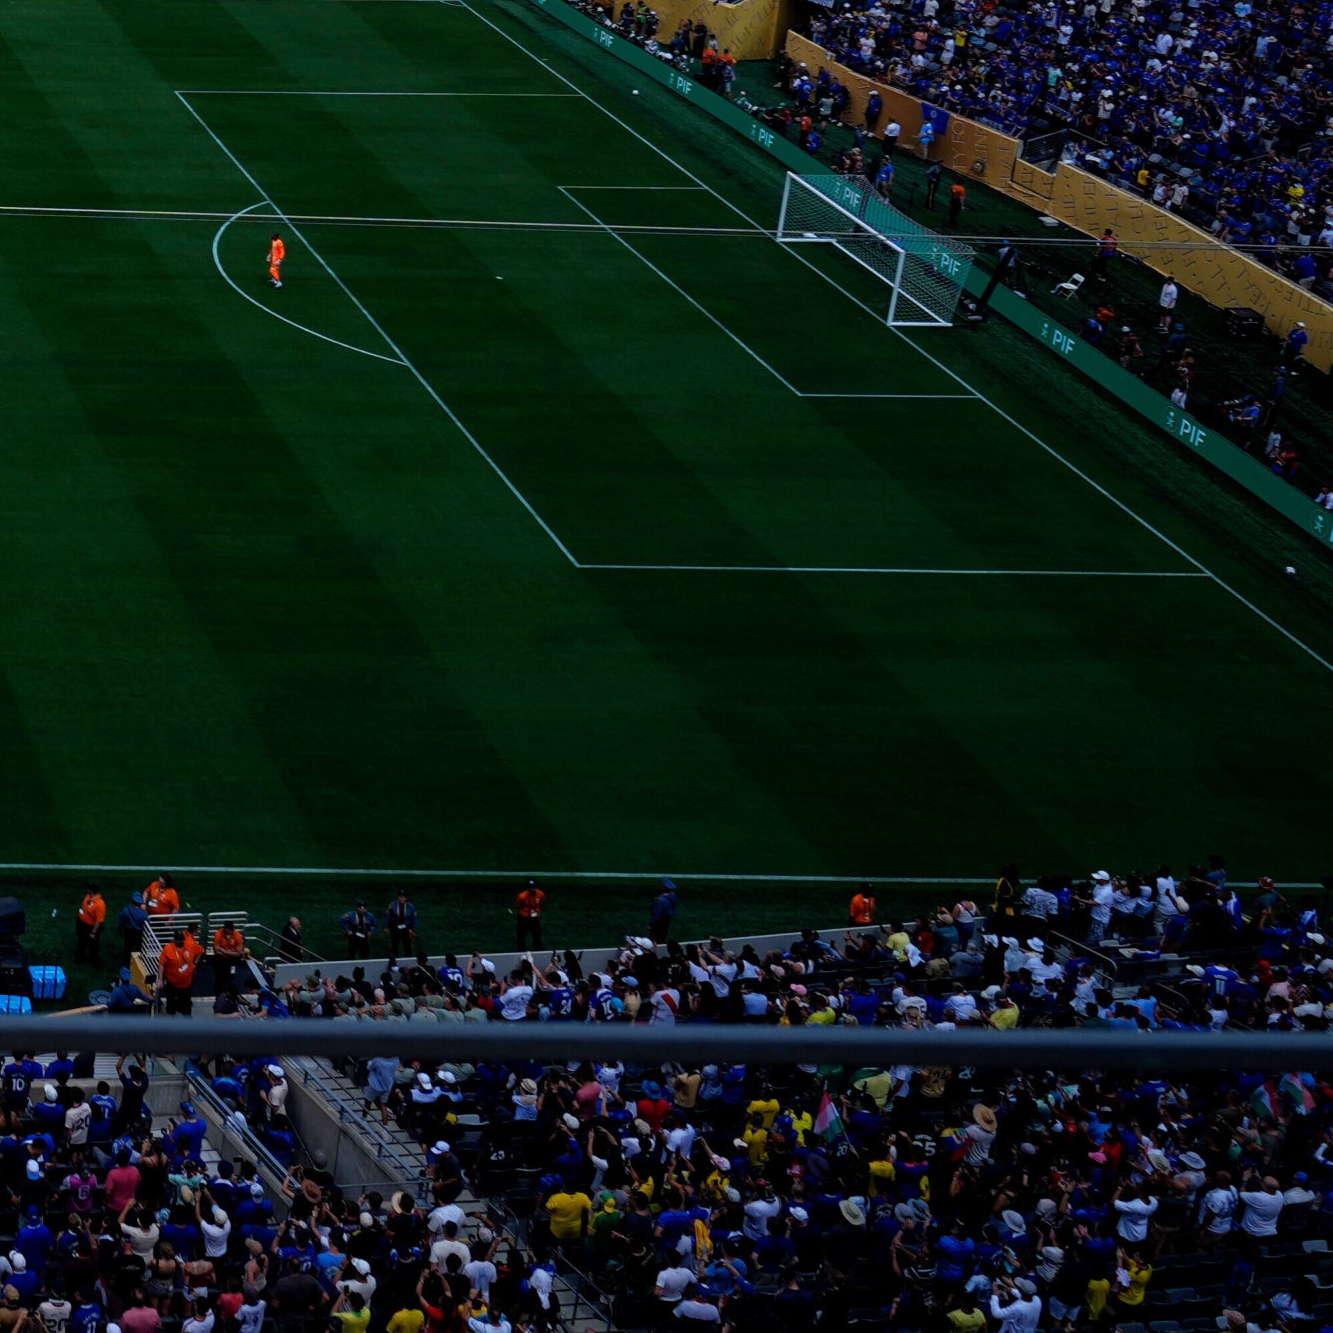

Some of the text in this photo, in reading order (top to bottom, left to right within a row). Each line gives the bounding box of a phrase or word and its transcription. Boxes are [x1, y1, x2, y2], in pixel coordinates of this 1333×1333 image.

[599, 30, 614, 48] PIF
[676, 76, 693, 95] PIF
[758, 128, 775, 148] PIF
[843, 186, 861, 208] PIF
[941, 252, 962, 277] PIF
[1052, 330, 1075, 355] PIF
[1179, 418, 1207, 447] PIF
[12, 1078, 25, 1091] 10
